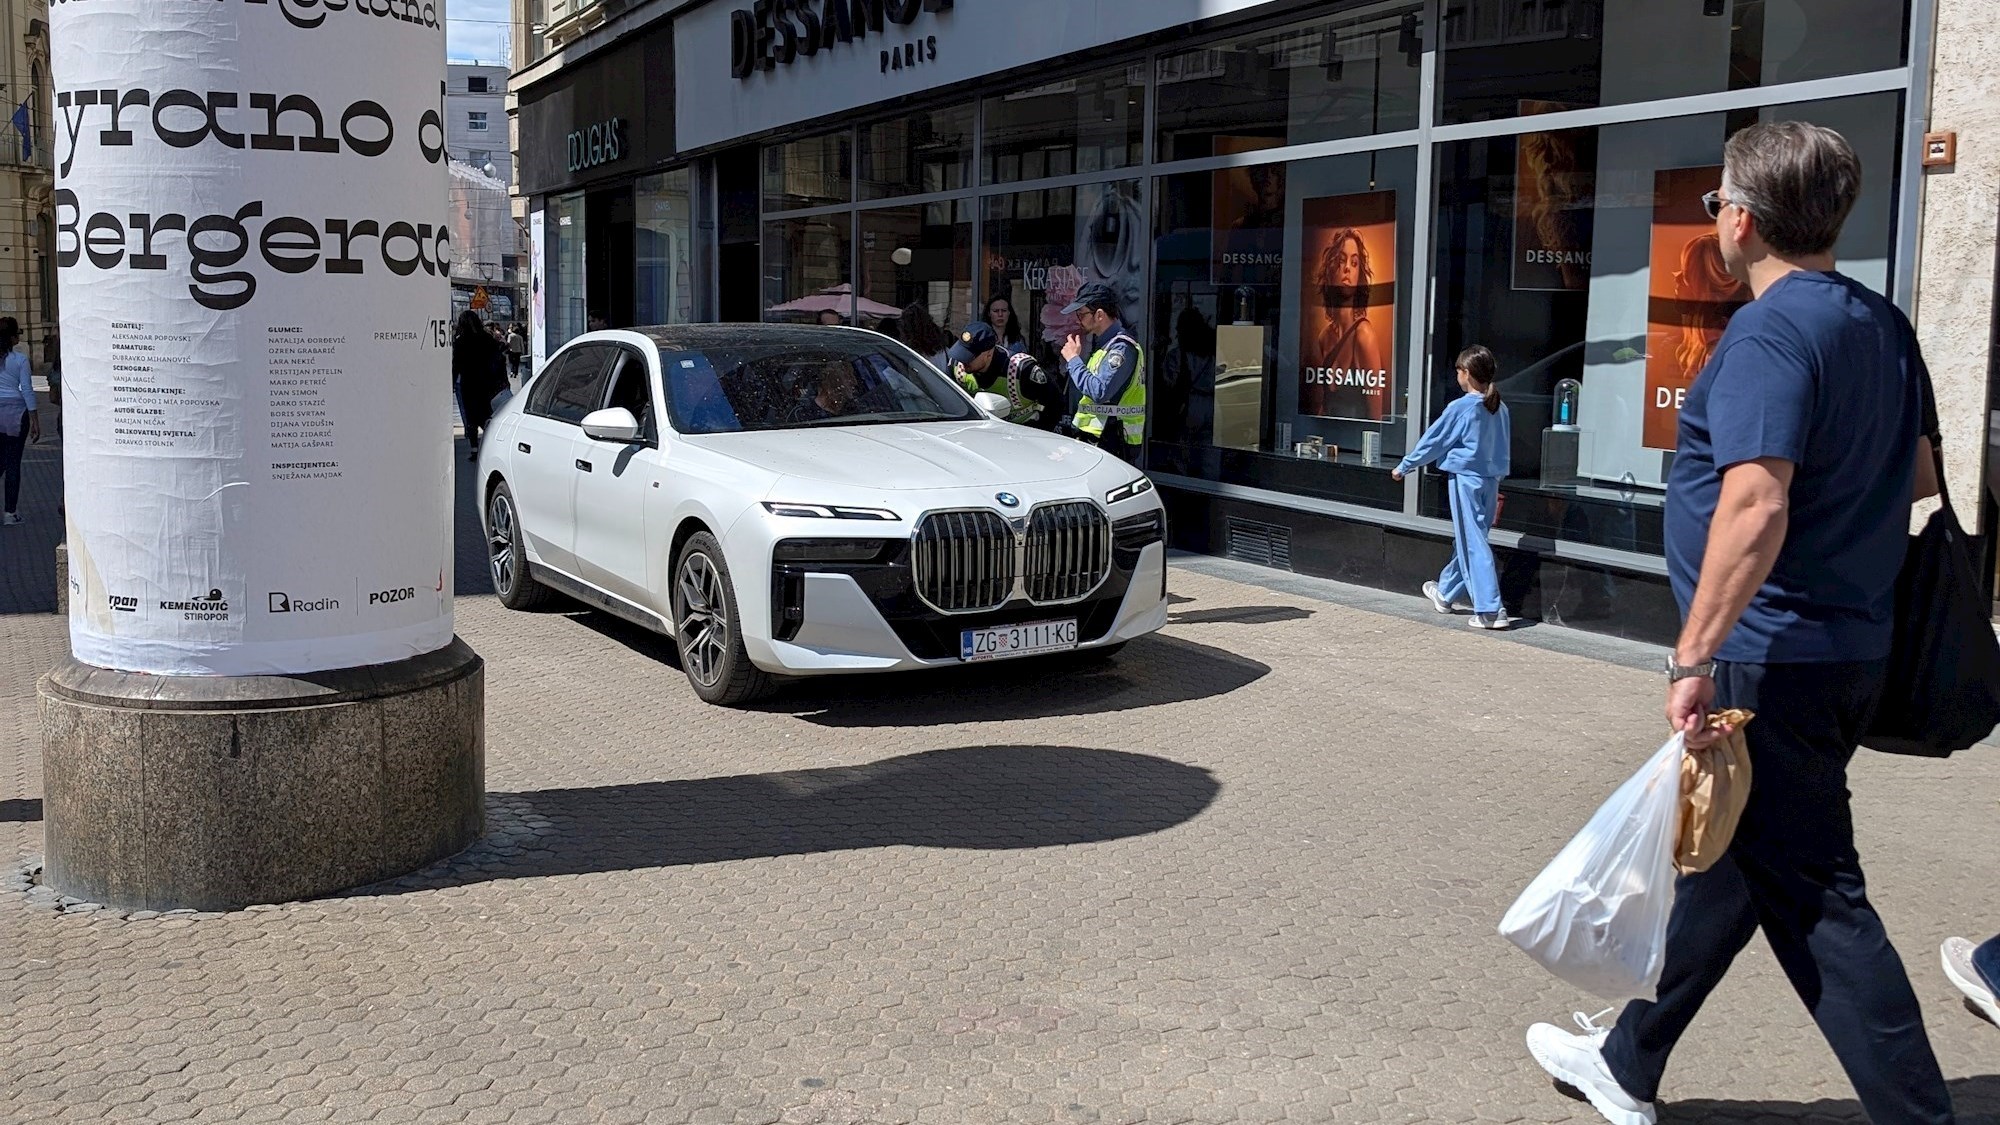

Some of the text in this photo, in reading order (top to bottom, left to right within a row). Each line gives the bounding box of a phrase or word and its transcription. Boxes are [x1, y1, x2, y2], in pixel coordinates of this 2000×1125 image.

[731, 0, 953, 78] DESSAN
[880, 36, 936, 73] PARIS
[53, 86, 393, 179] yrano
[567, 117, 619, 173] DOUGLAS
[111, 322, 144, 330] REDATELJ:
[111, 333, 152, 341] ALEKSANDAR
[374, 332, 418, 341] PREMIJERA
[297, 346, 335, 354] GRABARIĆ
[112, 354, 191, 363] DUBRAVKO MIHANOVIĆ
[291, 356, 315, 365] NEKIĆ
[113, 364, 153, 372] SCENOGRAF:
[113, 375, 132, 383] VANJA
[300, 377, 327, 385] PETRIĆ
[1305, 366, 1386, 388] DESSANGE
[113, 386, 186, 396] KOSTIMOGRAFKINJE:
[114, 396, 137, 404] MARITA
[1082, 405, 1145, 415] POLICIJA POLICIJA
[114, 418, 142, 426] MARIJAN
[114, 428, 161, 437] OBLIKOVATELJ
[115, 438, 143, 446] ZDRAVKO
[271, 461, 339, 470] INSPICIJENTICA:
[272, 471, 343, 480] SNJEŽANA MAJDAK
[369, 587, 415, 605] POZOR
[160, 600, 229, 611] KEMENOVIĆ
[293, 598, 340, 612] Radin
[184, 613, 229, 621] STIROPOR
[975, 631, 997, 653] ZG
